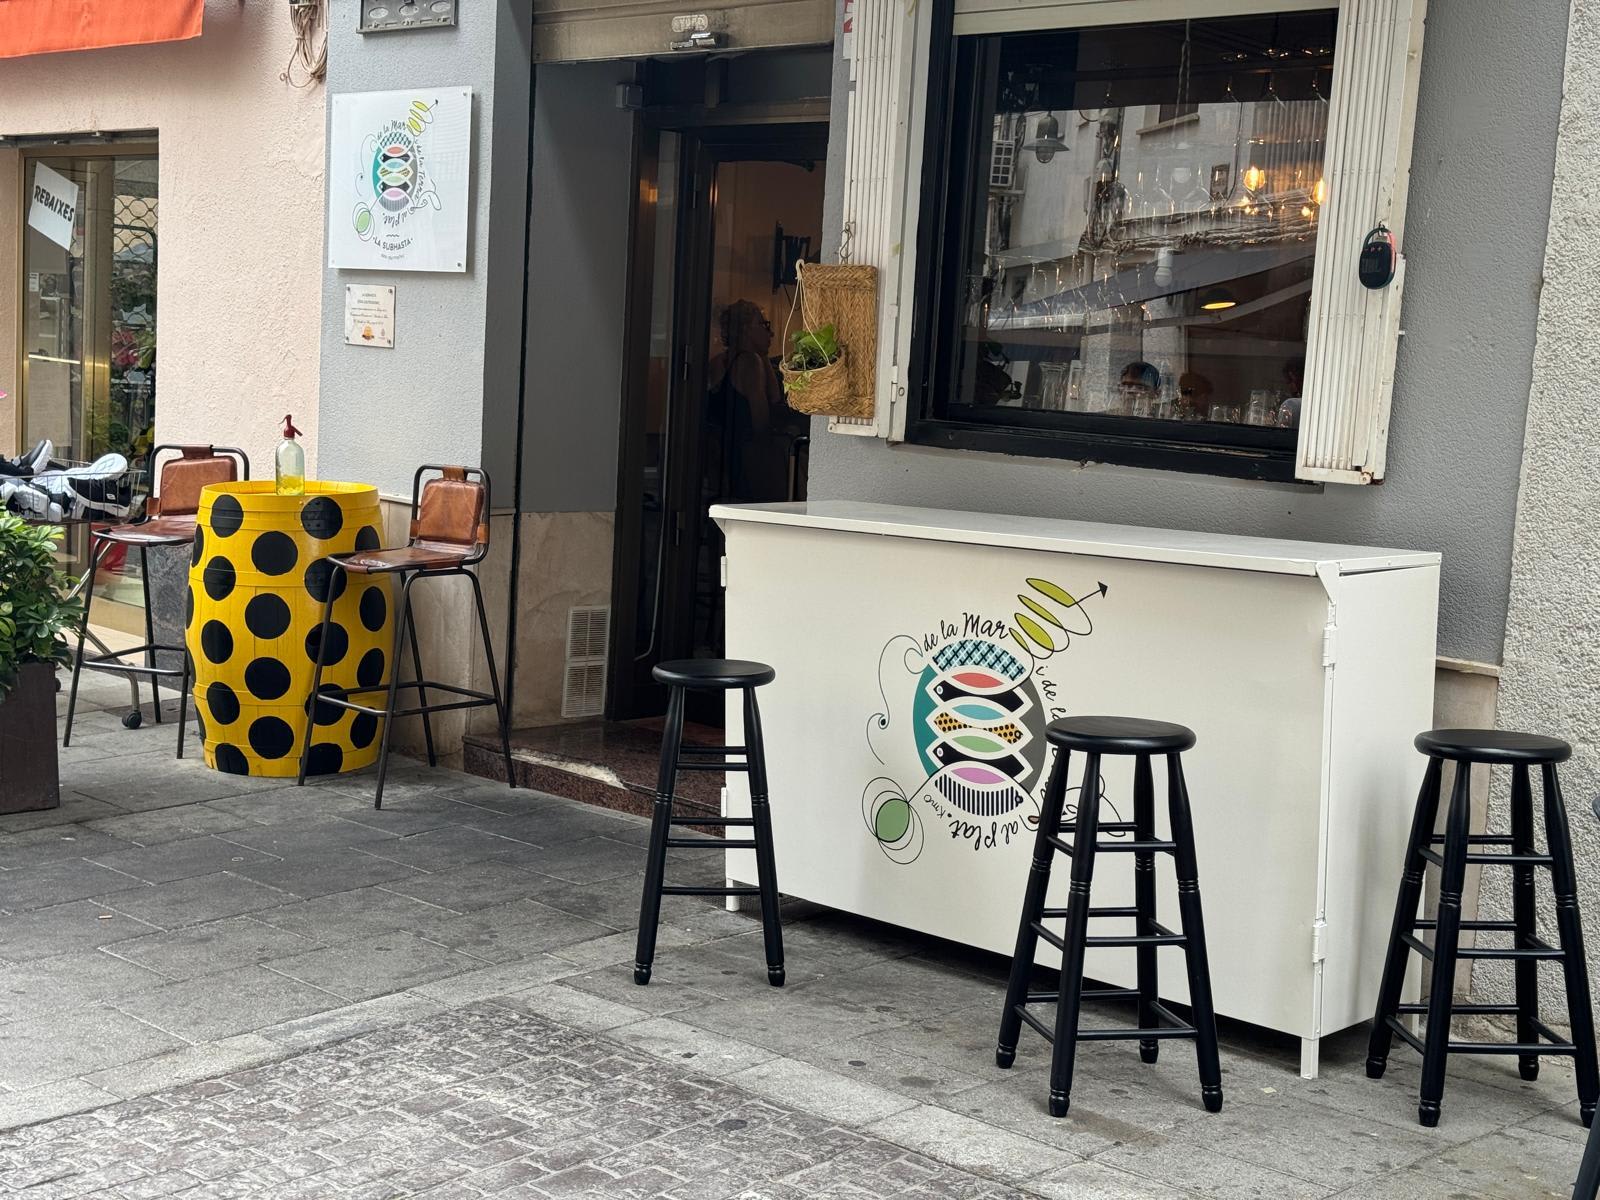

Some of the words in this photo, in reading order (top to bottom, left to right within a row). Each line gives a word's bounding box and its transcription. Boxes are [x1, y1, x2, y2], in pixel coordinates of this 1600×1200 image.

[391, 119, 407, 131] Mar
[34, 185, 74, 222] REBAIXES
[374, 236, 381, 246] LA
[382, 238, 411, 251] SUBHASTA
[923, 633, 938, 651] de
[940, 620, 958, 640] la
[962, 612, 1008, 639] Mar
[1035, 665, 1048, 676] i
[1042, 680, 1057, 701] de
[1000, 821, 1019, 844] al
